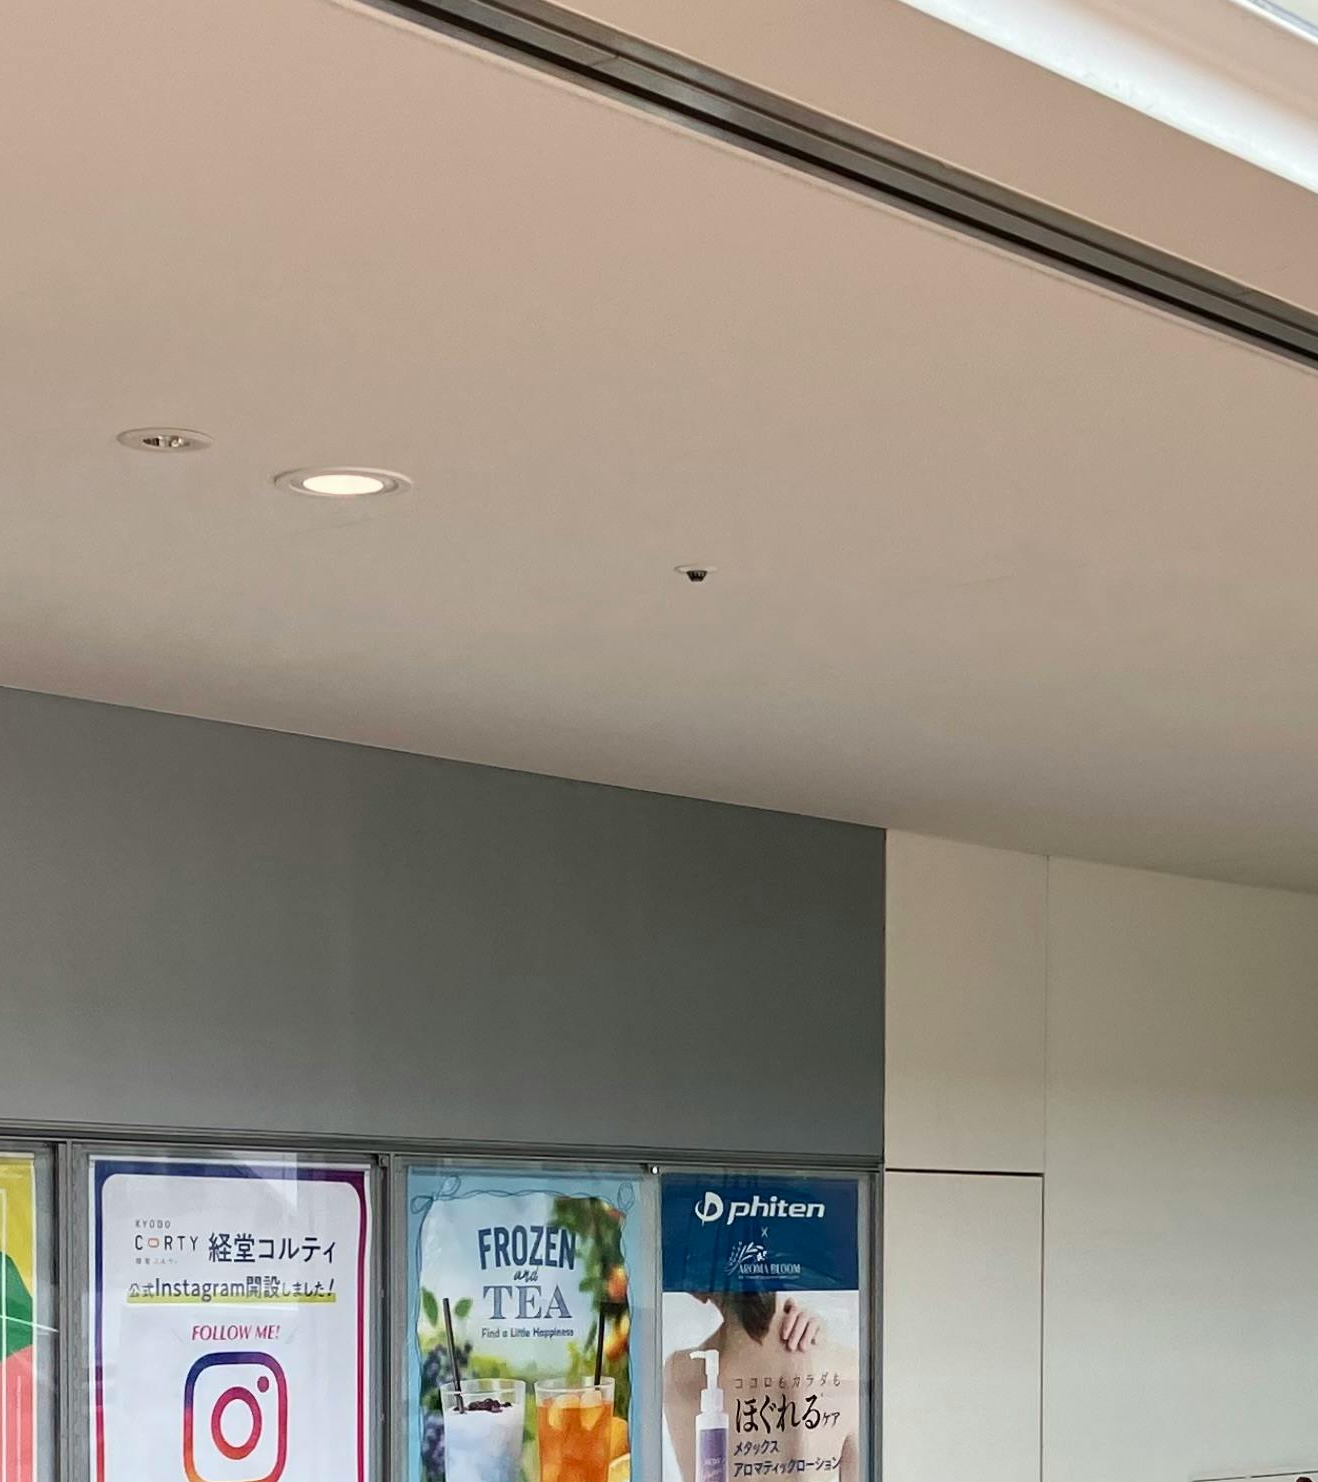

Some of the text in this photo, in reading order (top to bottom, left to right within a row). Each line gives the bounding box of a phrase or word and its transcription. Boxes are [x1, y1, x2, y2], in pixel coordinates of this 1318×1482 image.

[726, 1195, 826, 1226] phiten
[207, 1232, 337, 1265] 経堂コルティ
[478, 1225, 577, 1271] FROZEN
[513, 1267, 539, 1283] and
[738, 1263, 801, 1275] AROMA BLOOM
[482, 1284, 573, 1320] TEA
[191, 1324, 280, 1342] FOLLOW ME!
[481, 1326, 574, 1340] Find a Little Happiness
[734, 1440, 780, 1457] メタックス
[734, 1456, 842, 1478] アロマティックローション
